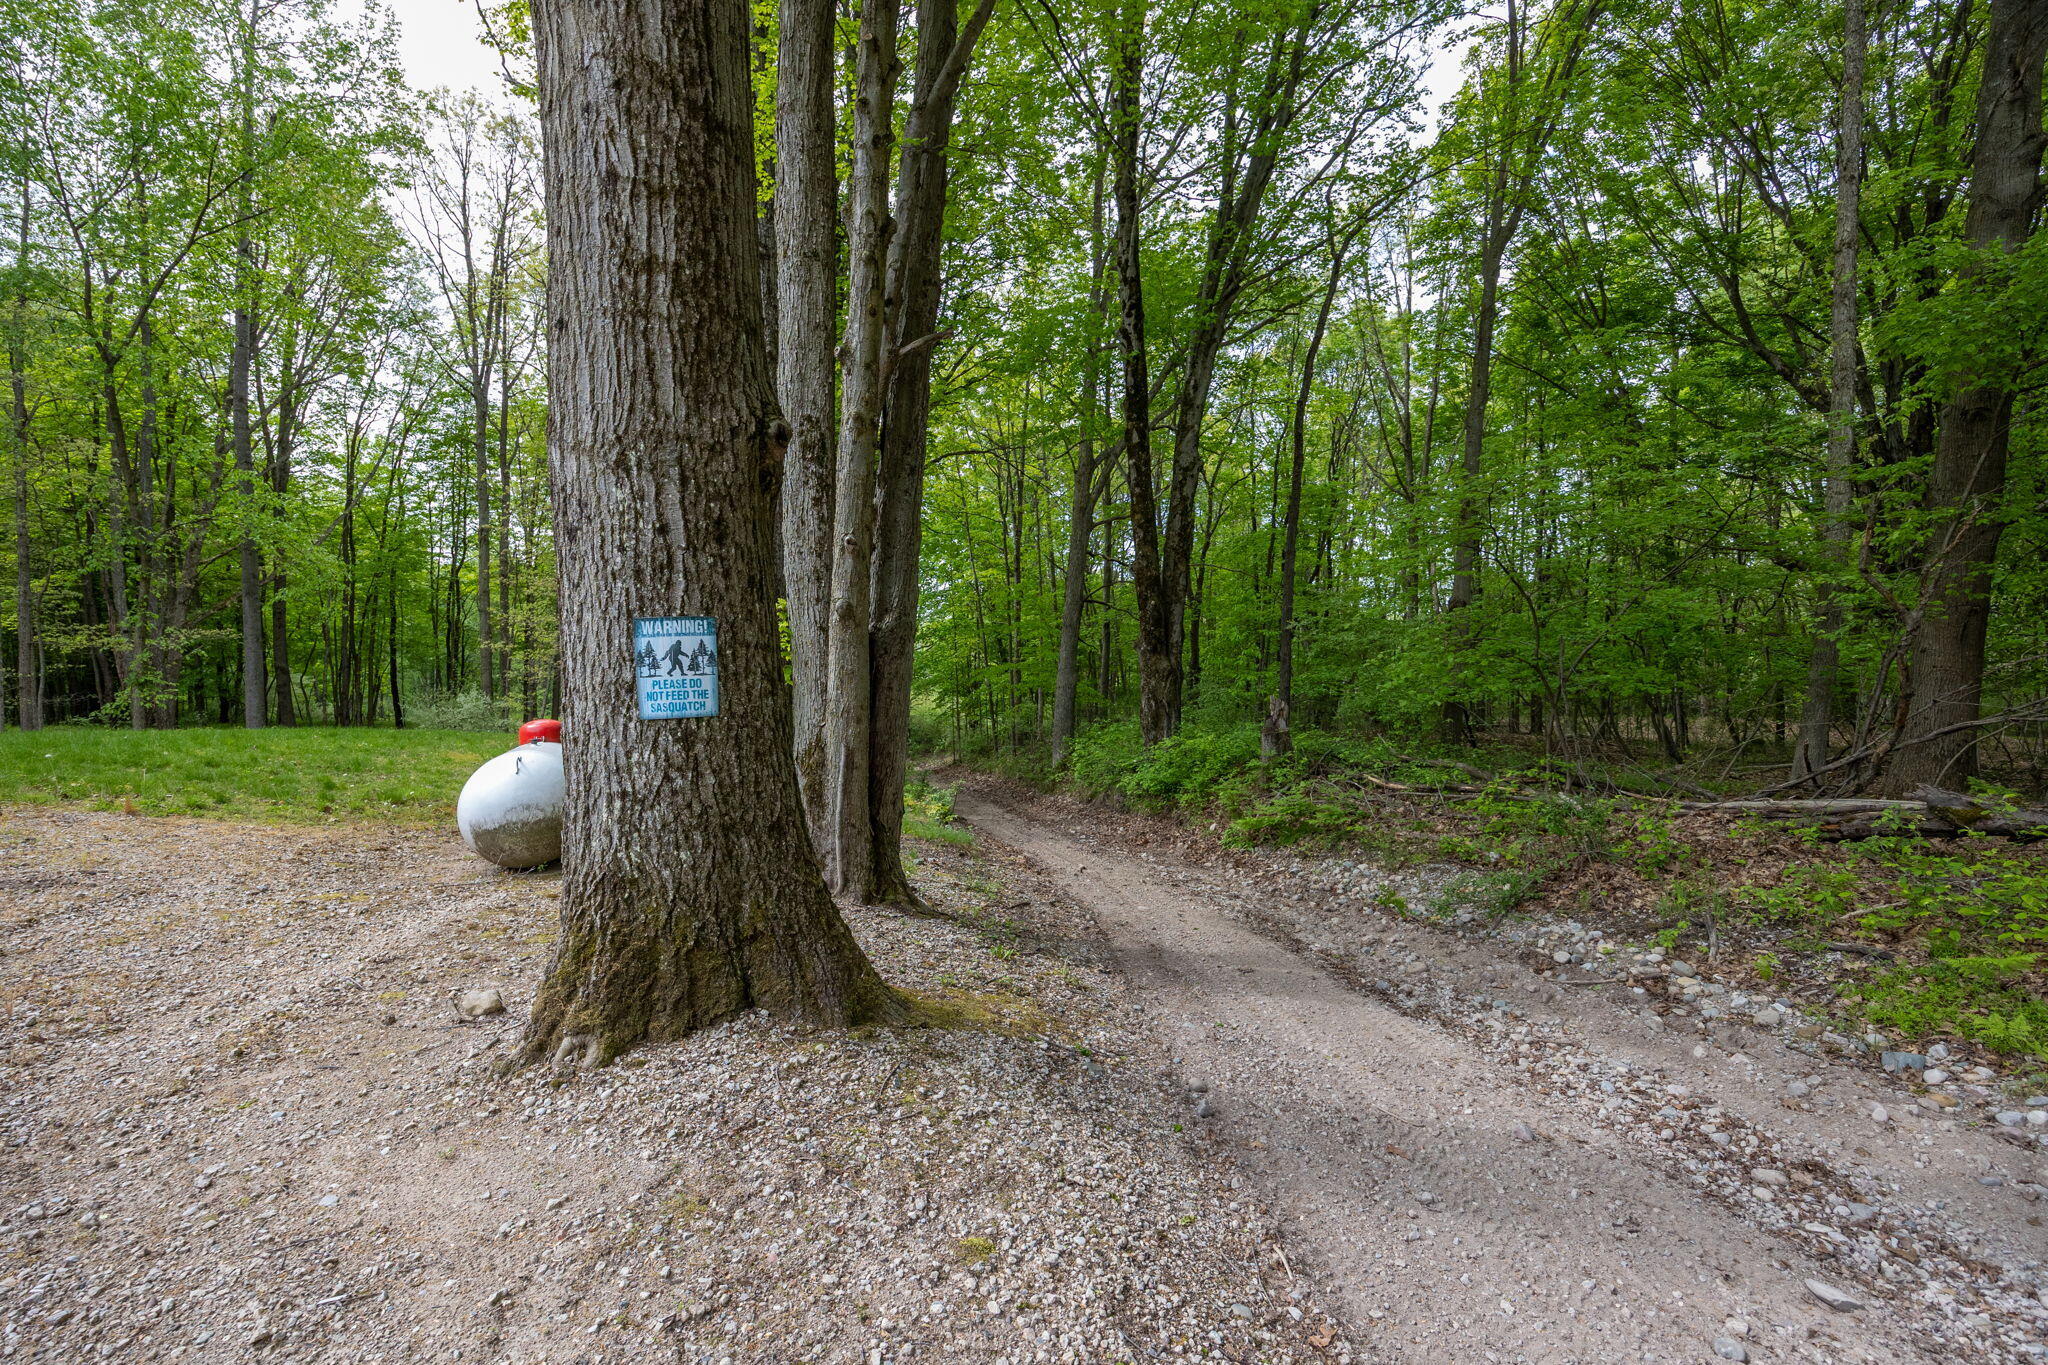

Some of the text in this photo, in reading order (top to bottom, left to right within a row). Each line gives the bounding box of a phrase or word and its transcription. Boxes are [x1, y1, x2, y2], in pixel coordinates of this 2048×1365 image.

[641, 620, 708, 634] WARNING!
[652, 678, 702, 690] PLEASE DO
[646, 689, 709, 702] NOT FEED THE
[650, 701, 706, 713] SASQUATCH
